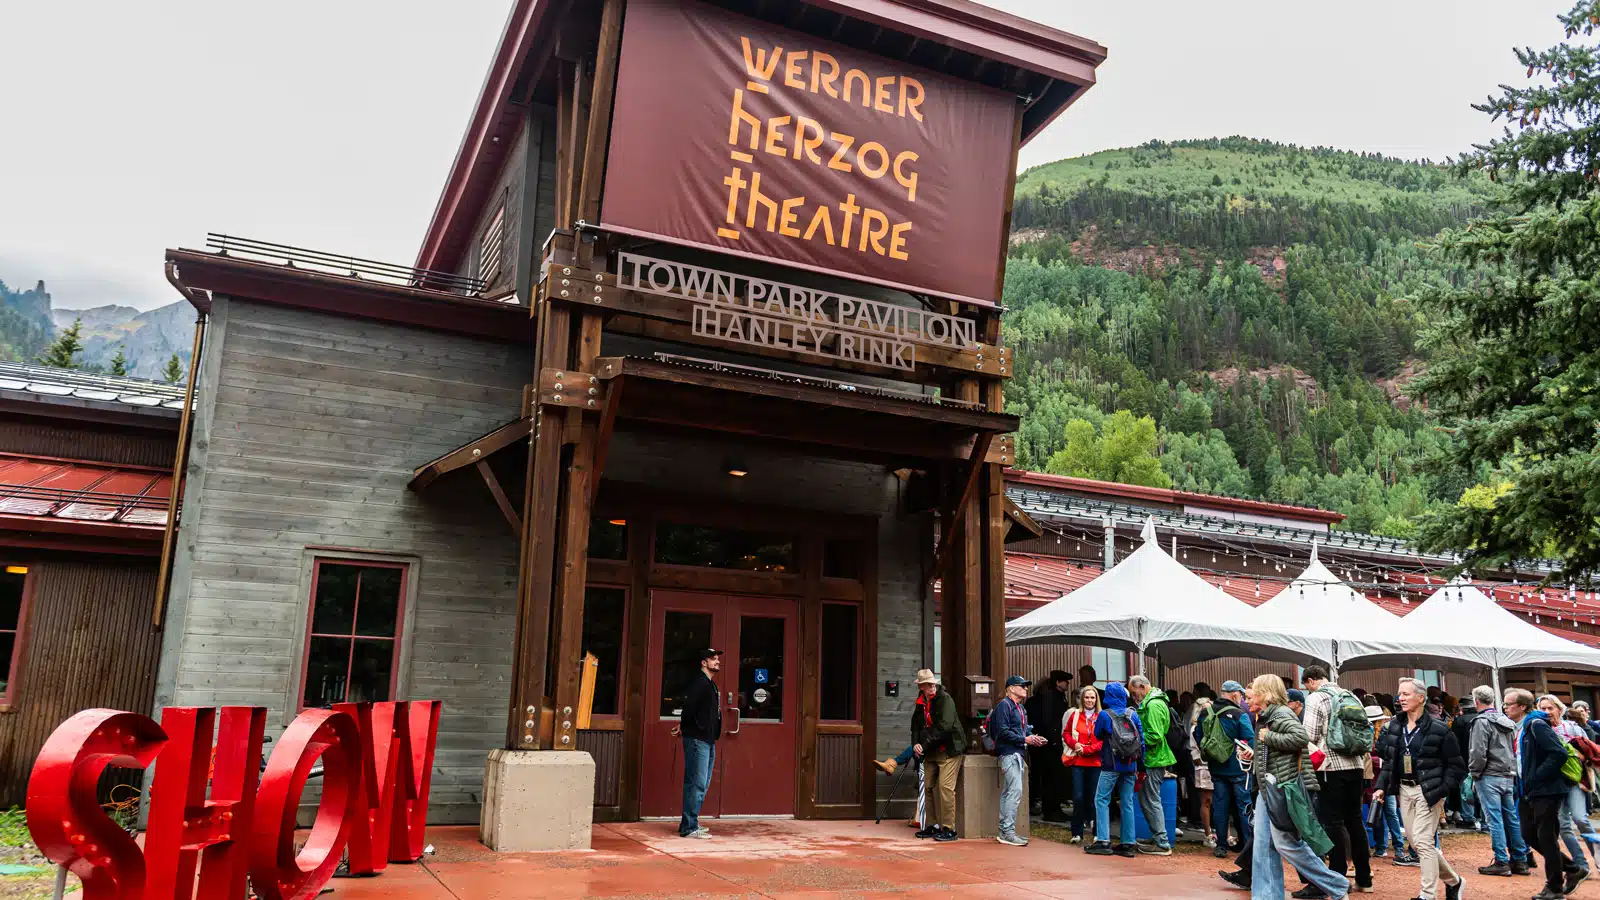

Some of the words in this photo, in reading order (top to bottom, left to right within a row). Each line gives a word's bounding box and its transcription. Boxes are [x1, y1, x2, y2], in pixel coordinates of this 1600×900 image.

[740, 37, 925, 122] WERNER
[626, 255, 736, 304] TOWN
[748, 280, 830, 325] PARK
[838, 297, 970, 349] PAVILION
[702, 306, 831, 355] HANLEY
[840, 333, 909, 369] RINK
[27, 700, 442, 900] SHOW
